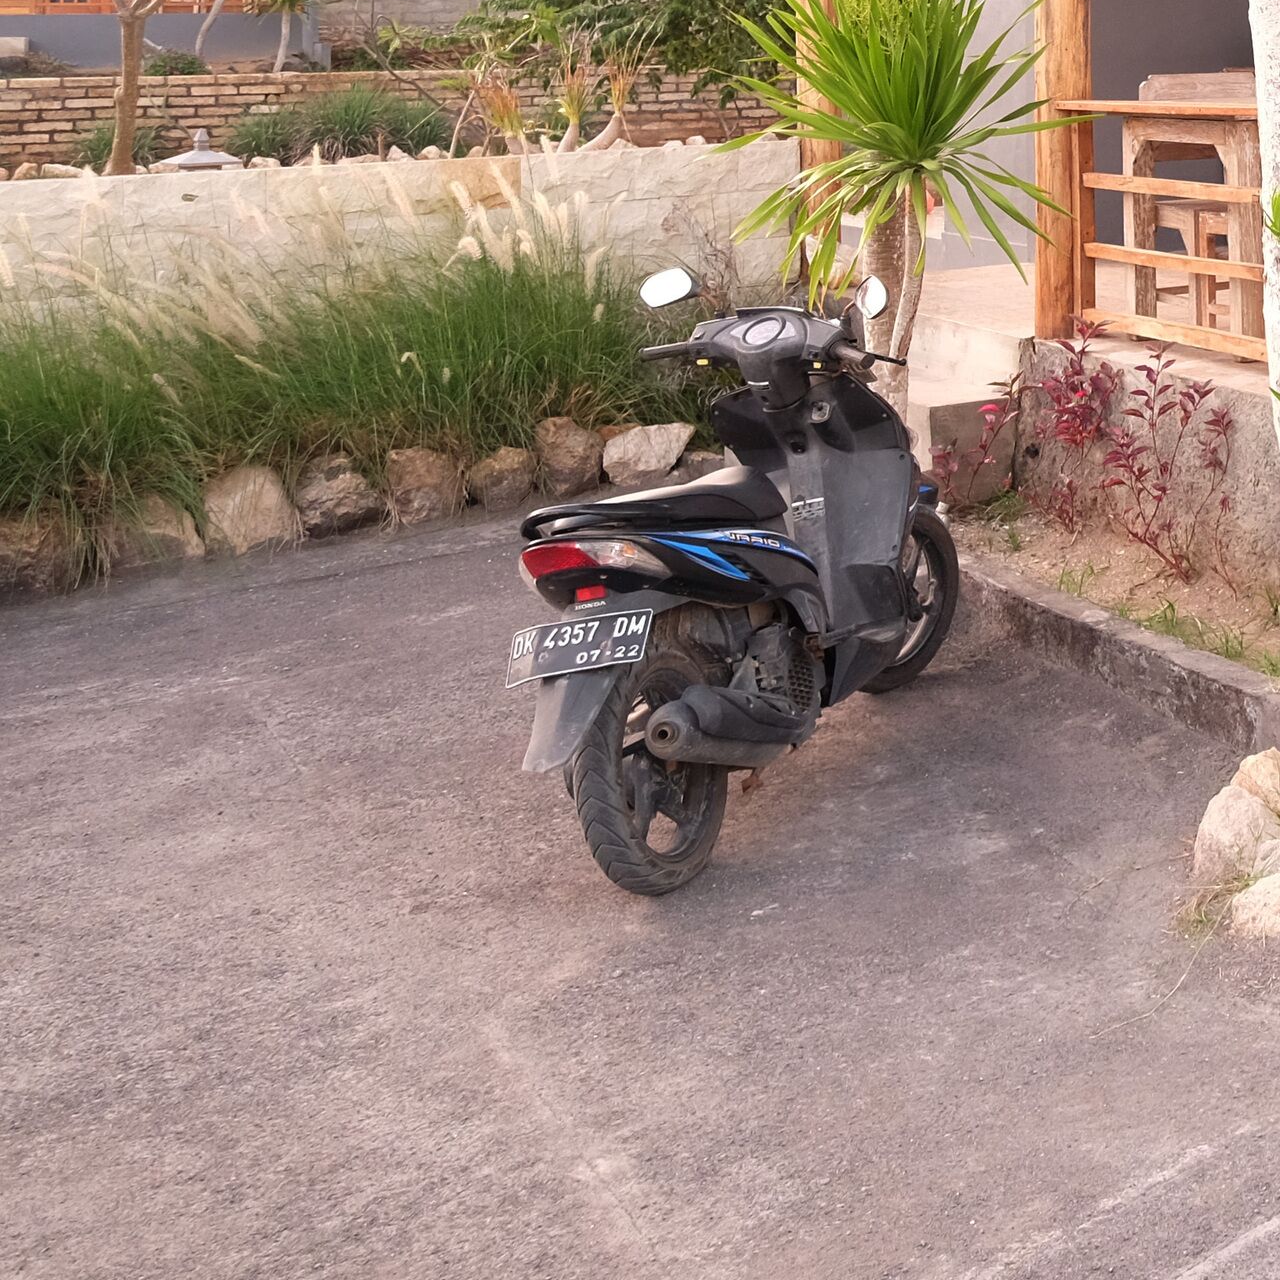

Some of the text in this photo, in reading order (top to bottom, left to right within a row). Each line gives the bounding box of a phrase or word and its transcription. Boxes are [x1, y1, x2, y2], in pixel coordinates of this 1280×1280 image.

[575, 600, 606, 611] HONDA
[513, 614, 647, 660] DK 4357 DM
